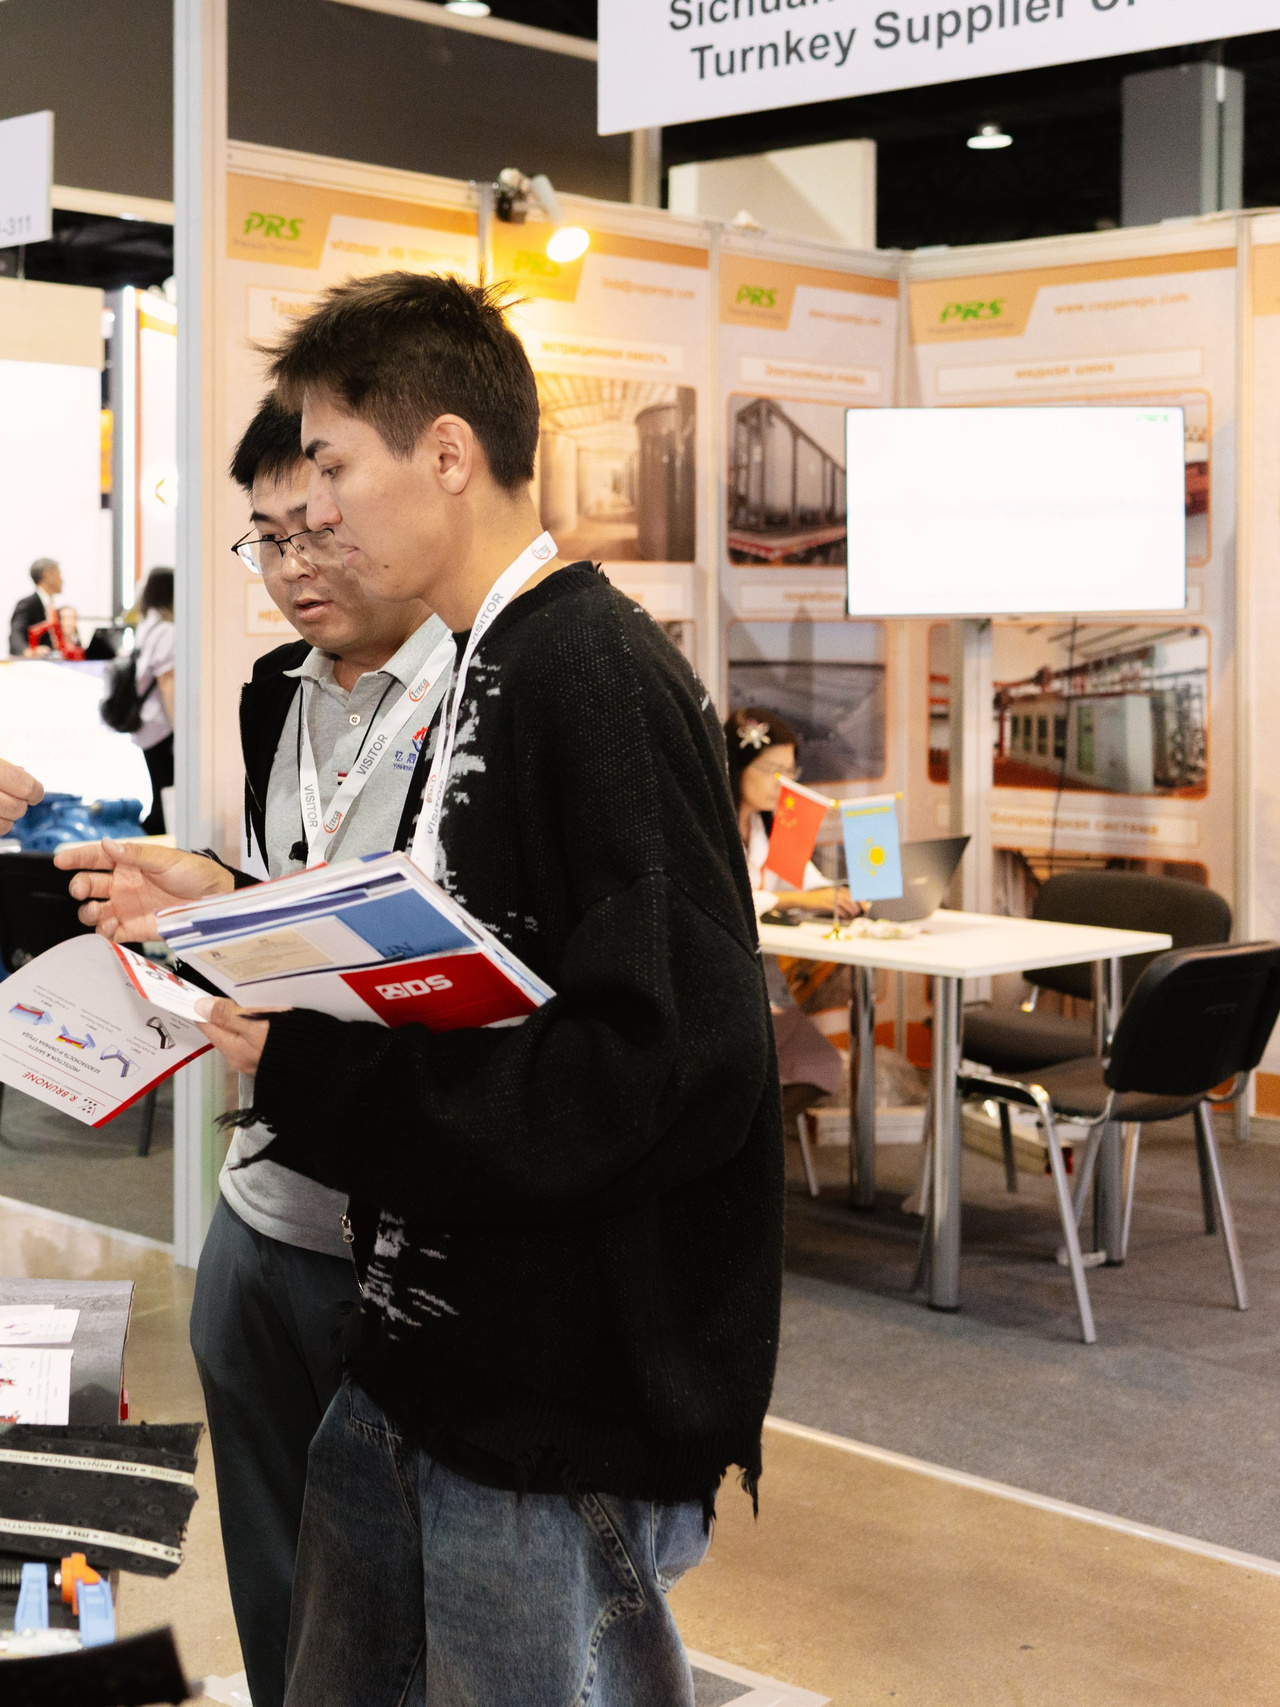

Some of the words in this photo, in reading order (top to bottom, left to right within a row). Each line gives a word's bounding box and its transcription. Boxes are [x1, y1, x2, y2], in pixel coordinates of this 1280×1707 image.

[690, 27, 856, 80] Turnkey
[244, 211, 304, 241] PRS
[736, 284, 777, 308] PRS
[939, 298, 1007, 323] PRS
[470, 593, 504, 645] VISITOR
[356, 733, 388, 776] VISITOR
[304, 784, 318, 828] VISITOR
[428, 780, 444, 835] VISITOR
[40, 1456, 113, 1470] INNOVATION
